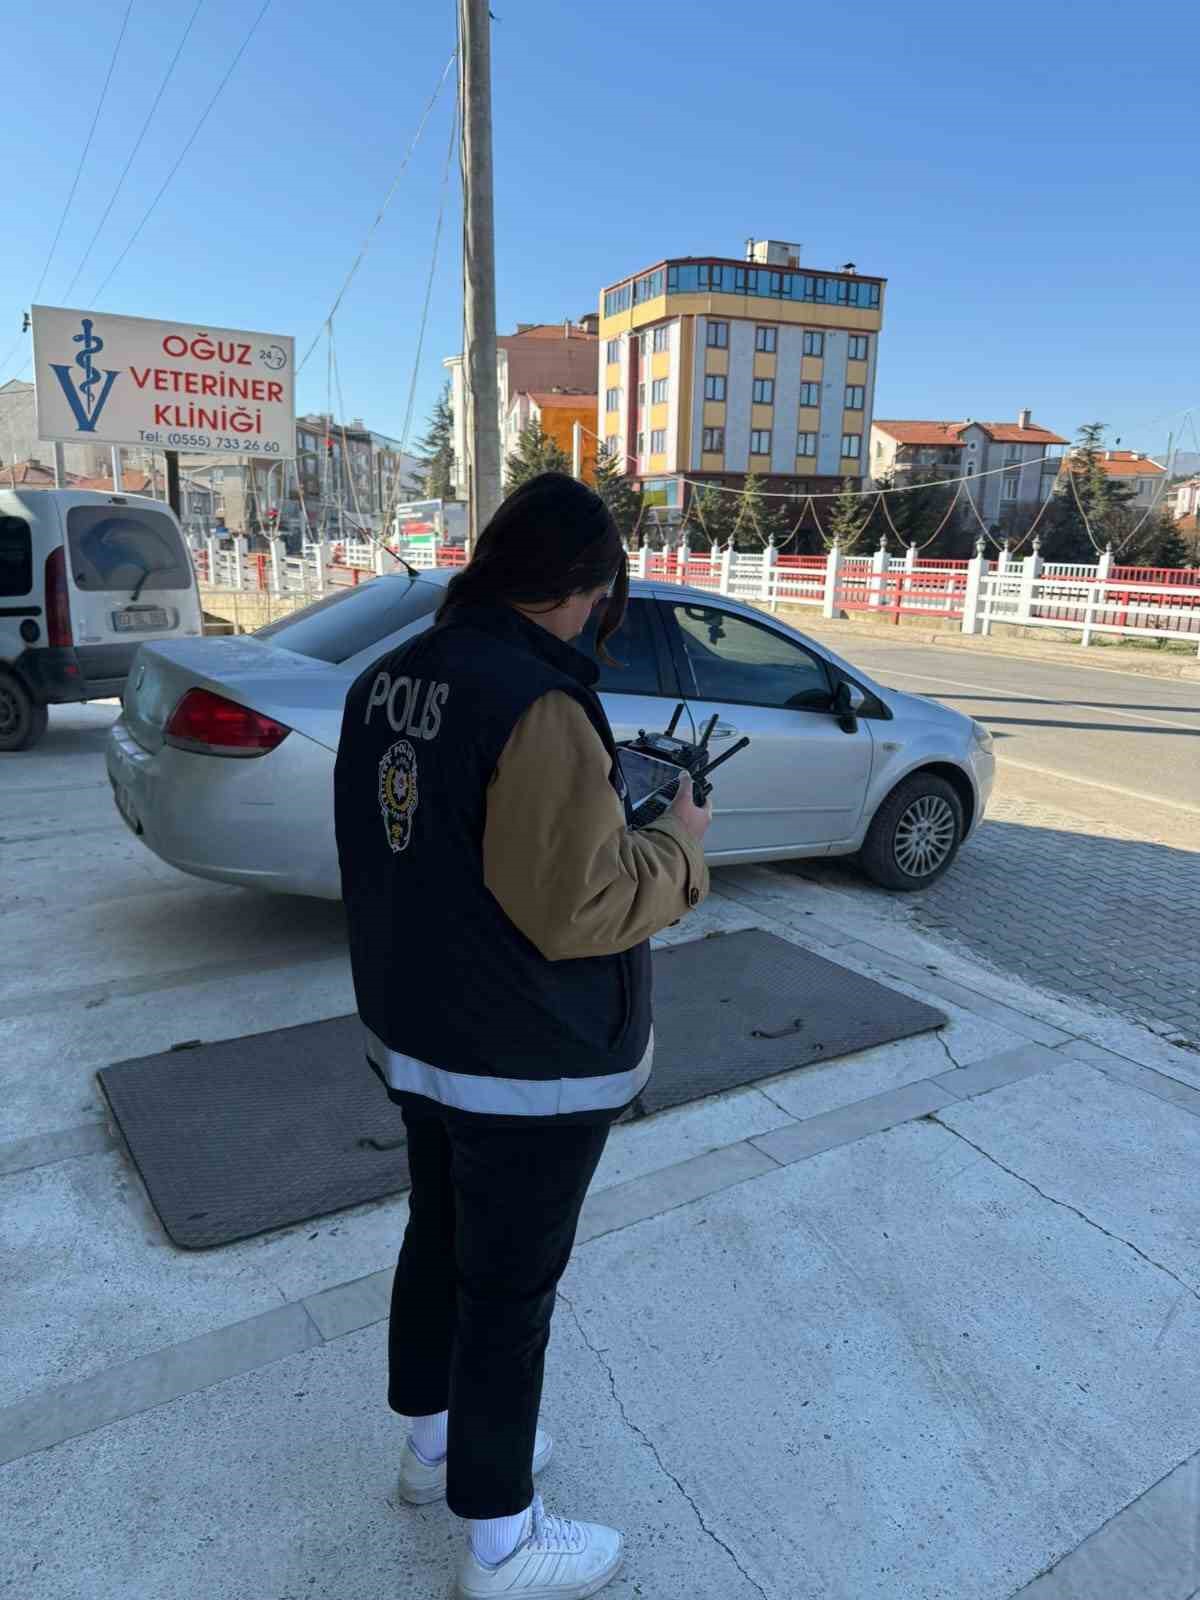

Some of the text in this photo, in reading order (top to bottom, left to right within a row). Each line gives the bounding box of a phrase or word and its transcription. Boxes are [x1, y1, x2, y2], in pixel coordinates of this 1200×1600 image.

[162, 332, 252, 365] OĞUZ
[129, 366, 284, 403] VETERİNER
[154, 402, 262, 434] KLİNİĞİ
[138, 430, 280, 453] Tel: (0555) 733 26 60
